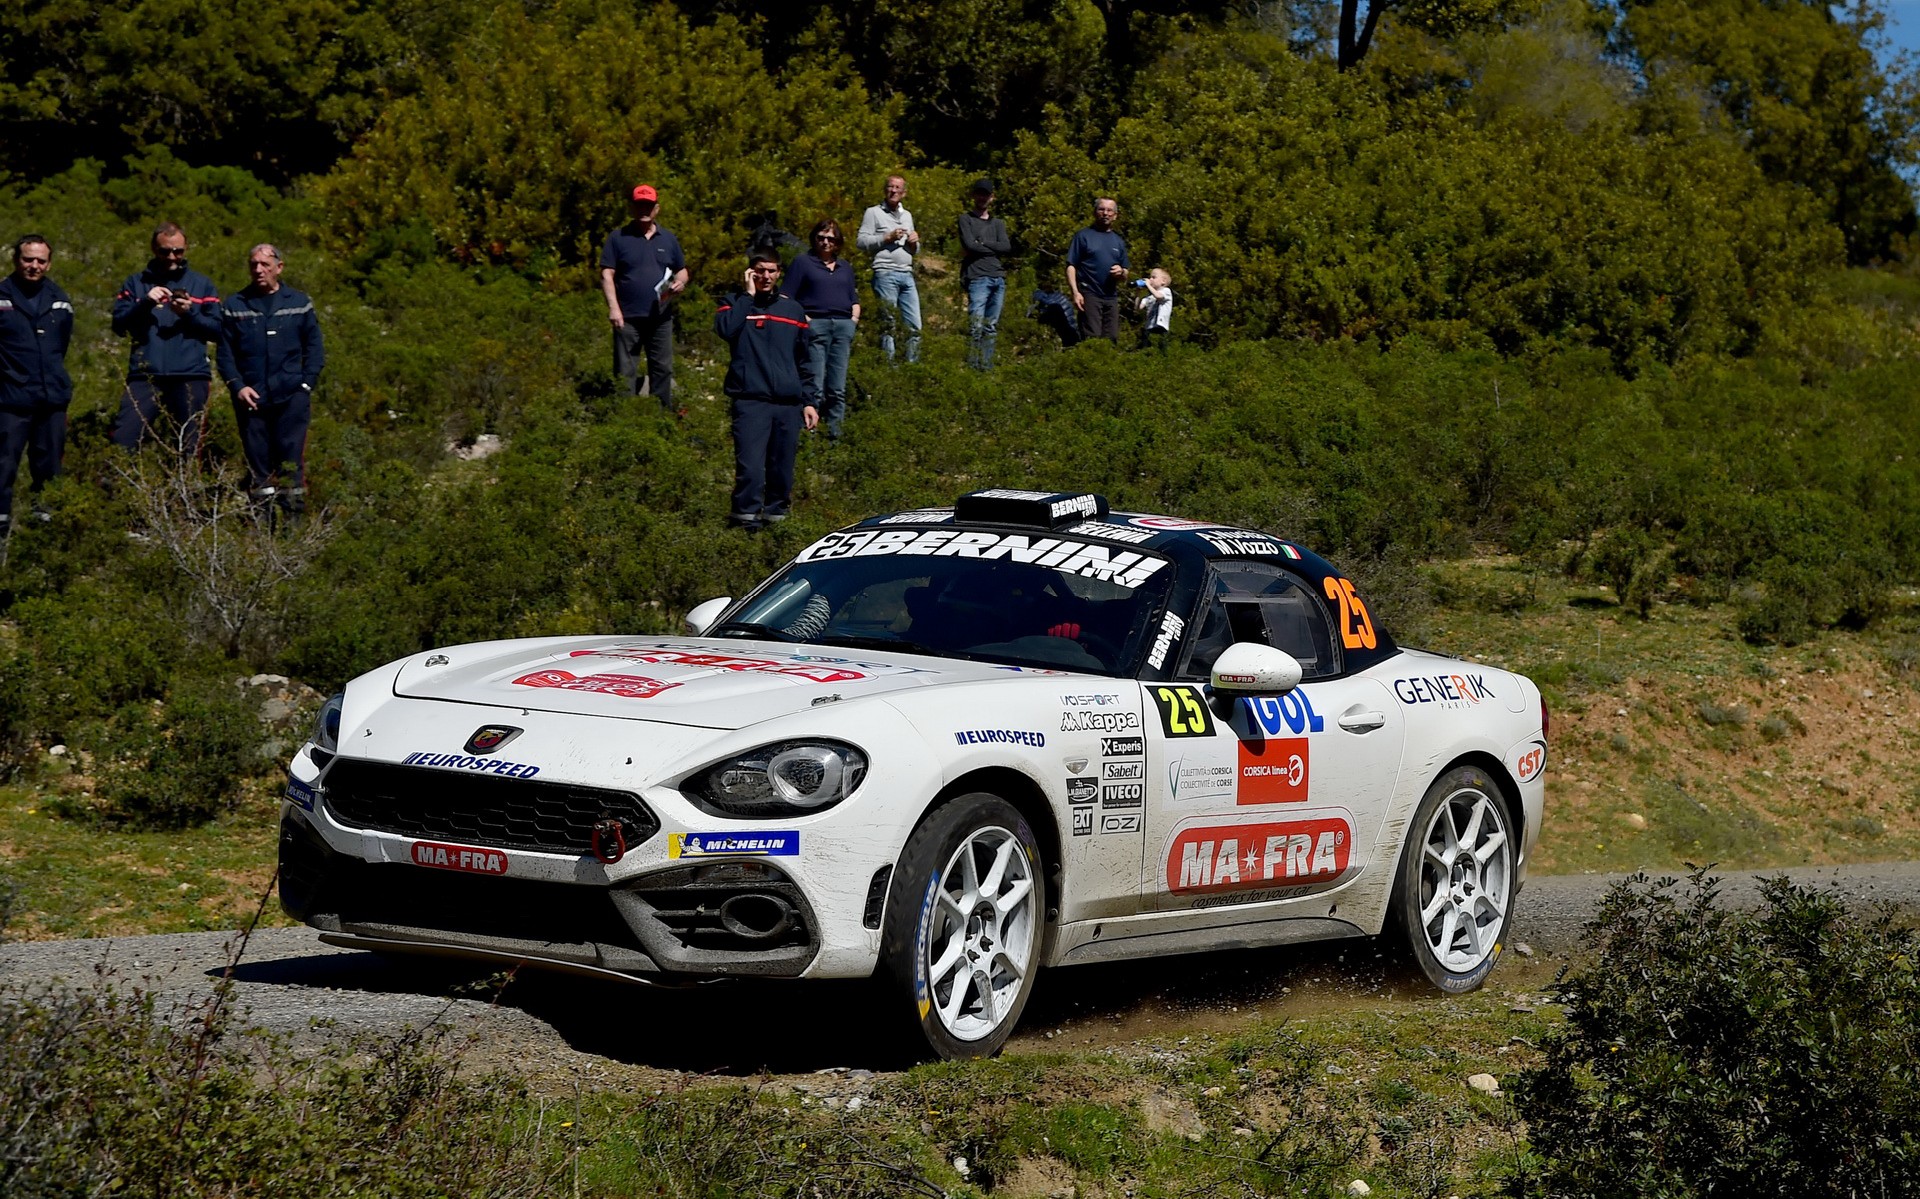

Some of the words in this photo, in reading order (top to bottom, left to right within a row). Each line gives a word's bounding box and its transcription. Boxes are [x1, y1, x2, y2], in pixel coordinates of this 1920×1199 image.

[1051, 494, 1096, 518] BERNINI
[807, 533, 868, 561] 25
[854, 531, 1169, 581] BERNINI
[1210, 539, 1279, 555] M.Vozzo
[1323, 576, 1376, 650] 25
[1147, 610, 1175, 671] BERNINI
[1394, 674, 1496, 704] GENERIK
[1157, 687, 1206, 734] 25
[1441, 702, 1471, 710] PARIS
[1080, 711, 1139, 732] Kappa
[966, 730, 1045, 748] EUROSPEED
[1113, 741, 1141, 755] Experis
[416, 752, 541, 778] EUROSPEED
[1108, 764, 1138, 777] Sabelt
[1211, 767, 1232, 775] CORSICA
[1243, 766, 1271, 777] CORSICA
[1272, 766, 1288, 775] linea
[1518, 748, 1541, 778] CST
[1217, 778, 1232, 787] CORSE
[1106, 785, 1140, 800] IVECO
[1106, 817, 1136, 830] OZ
[705, 839, 785, 850] MICHELIN
[1191, 892, 1244, 908] cosmetics
[1246, 889, 1264, 902] for
[1266, 889, 1291, 900] your
[1293, 886, 1312, 896] car
